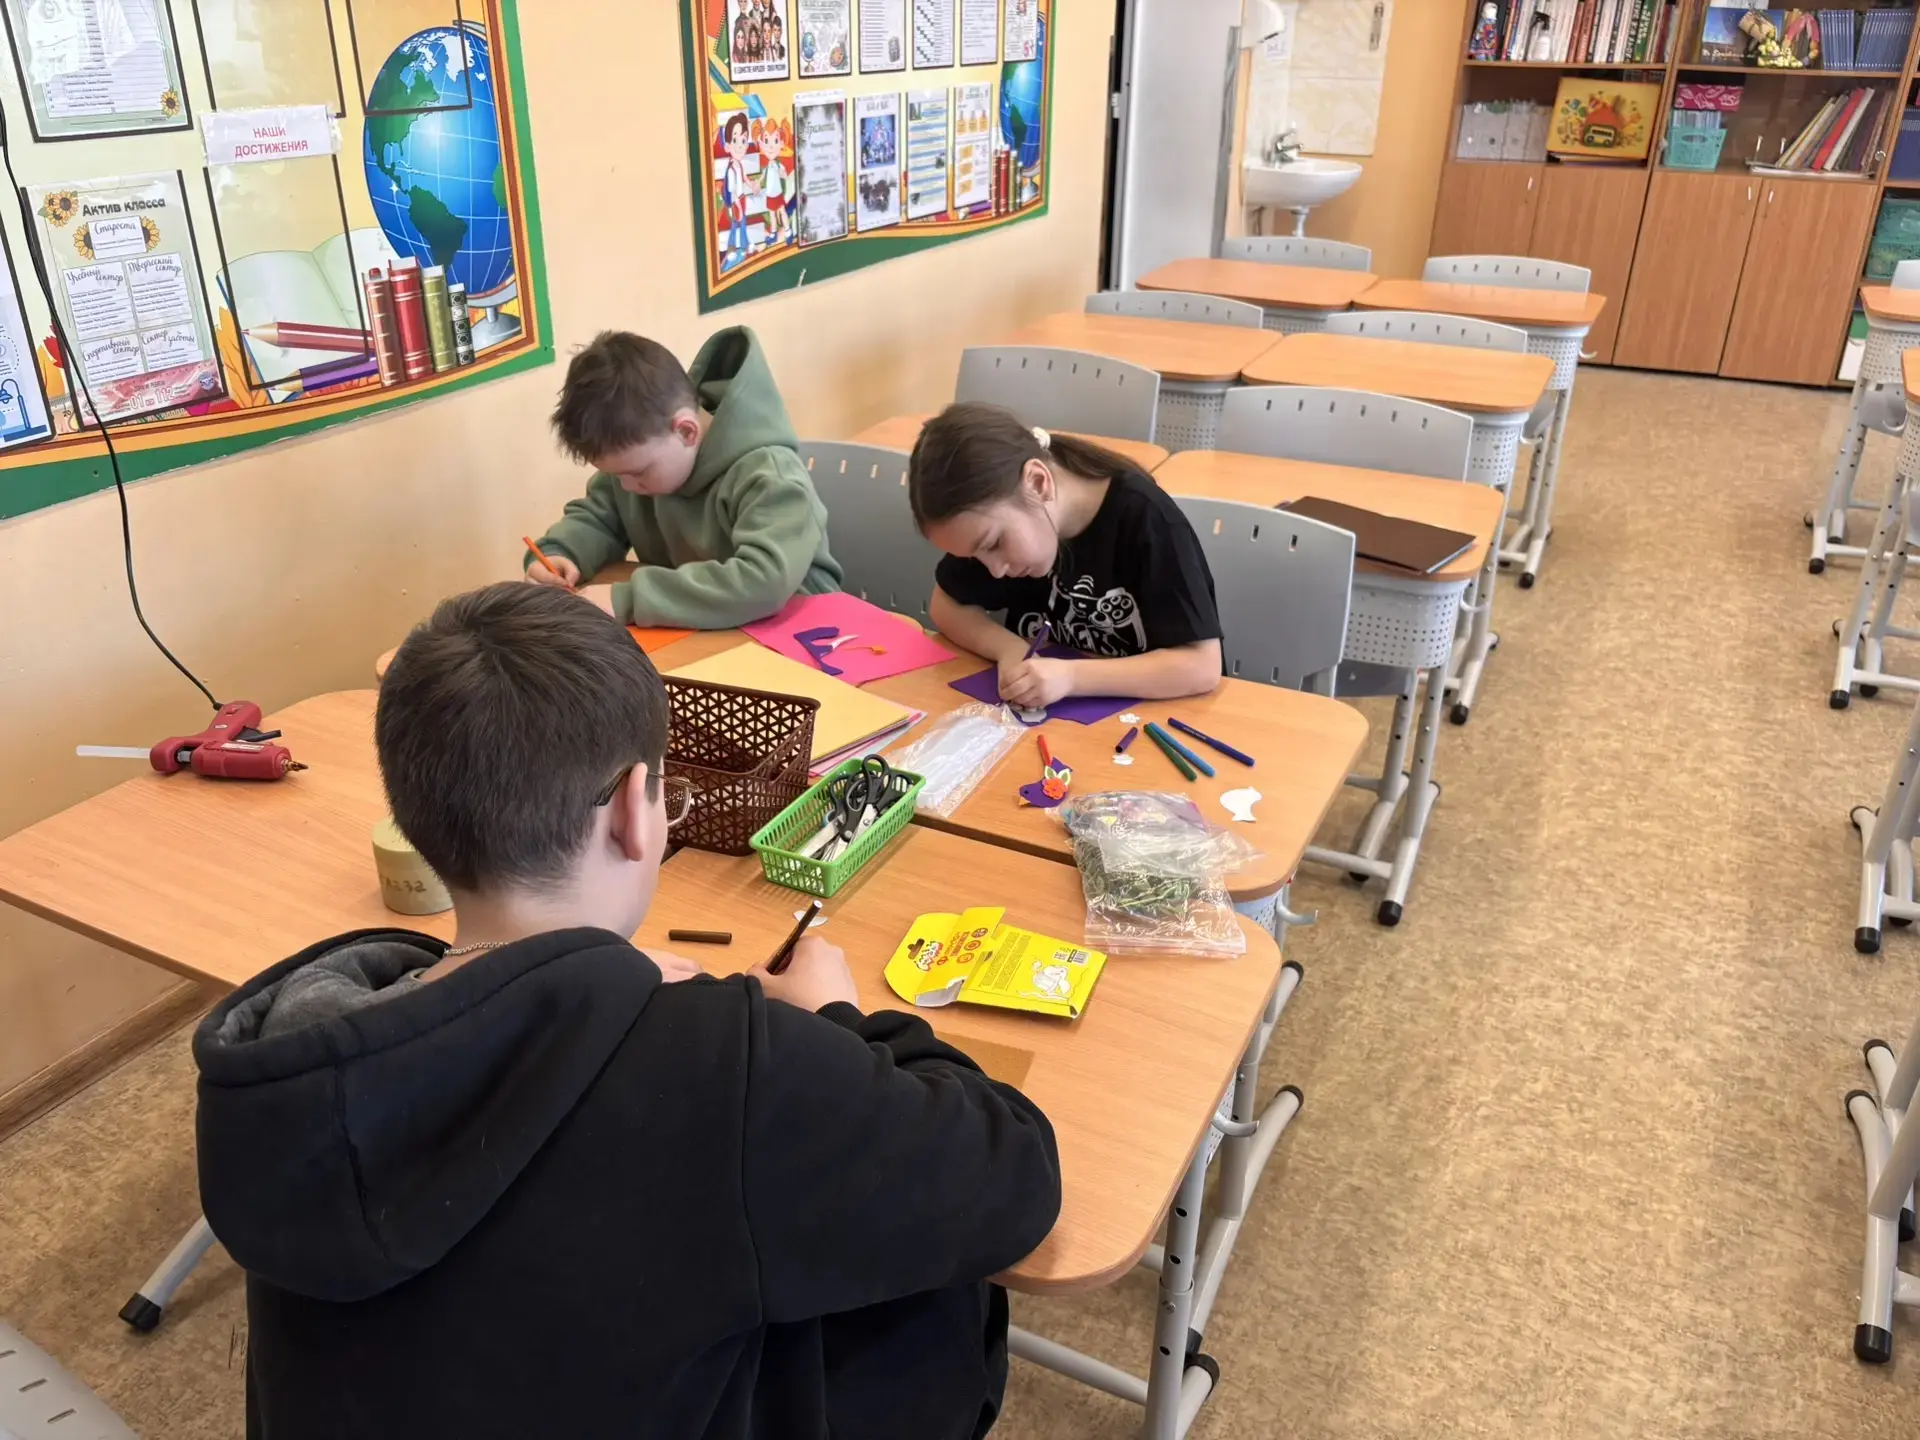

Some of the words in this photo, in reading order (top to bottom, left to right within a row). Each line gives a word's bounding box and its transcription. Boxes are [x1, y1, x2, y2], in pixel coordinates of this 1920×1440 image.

[253, 126, 287, 139] НАШИ
[234, 140, 309, 158] ДОСТИЖЕНИЯ
[82, 203, 122, 217] Актив
[124, 198, 166, 212] класса
[94, 222, 137, 236] Староста
[66, 266, 101, 285] Учебный
[130, 393, 145, 410] 01
[155, 386, 174, 404] 112
